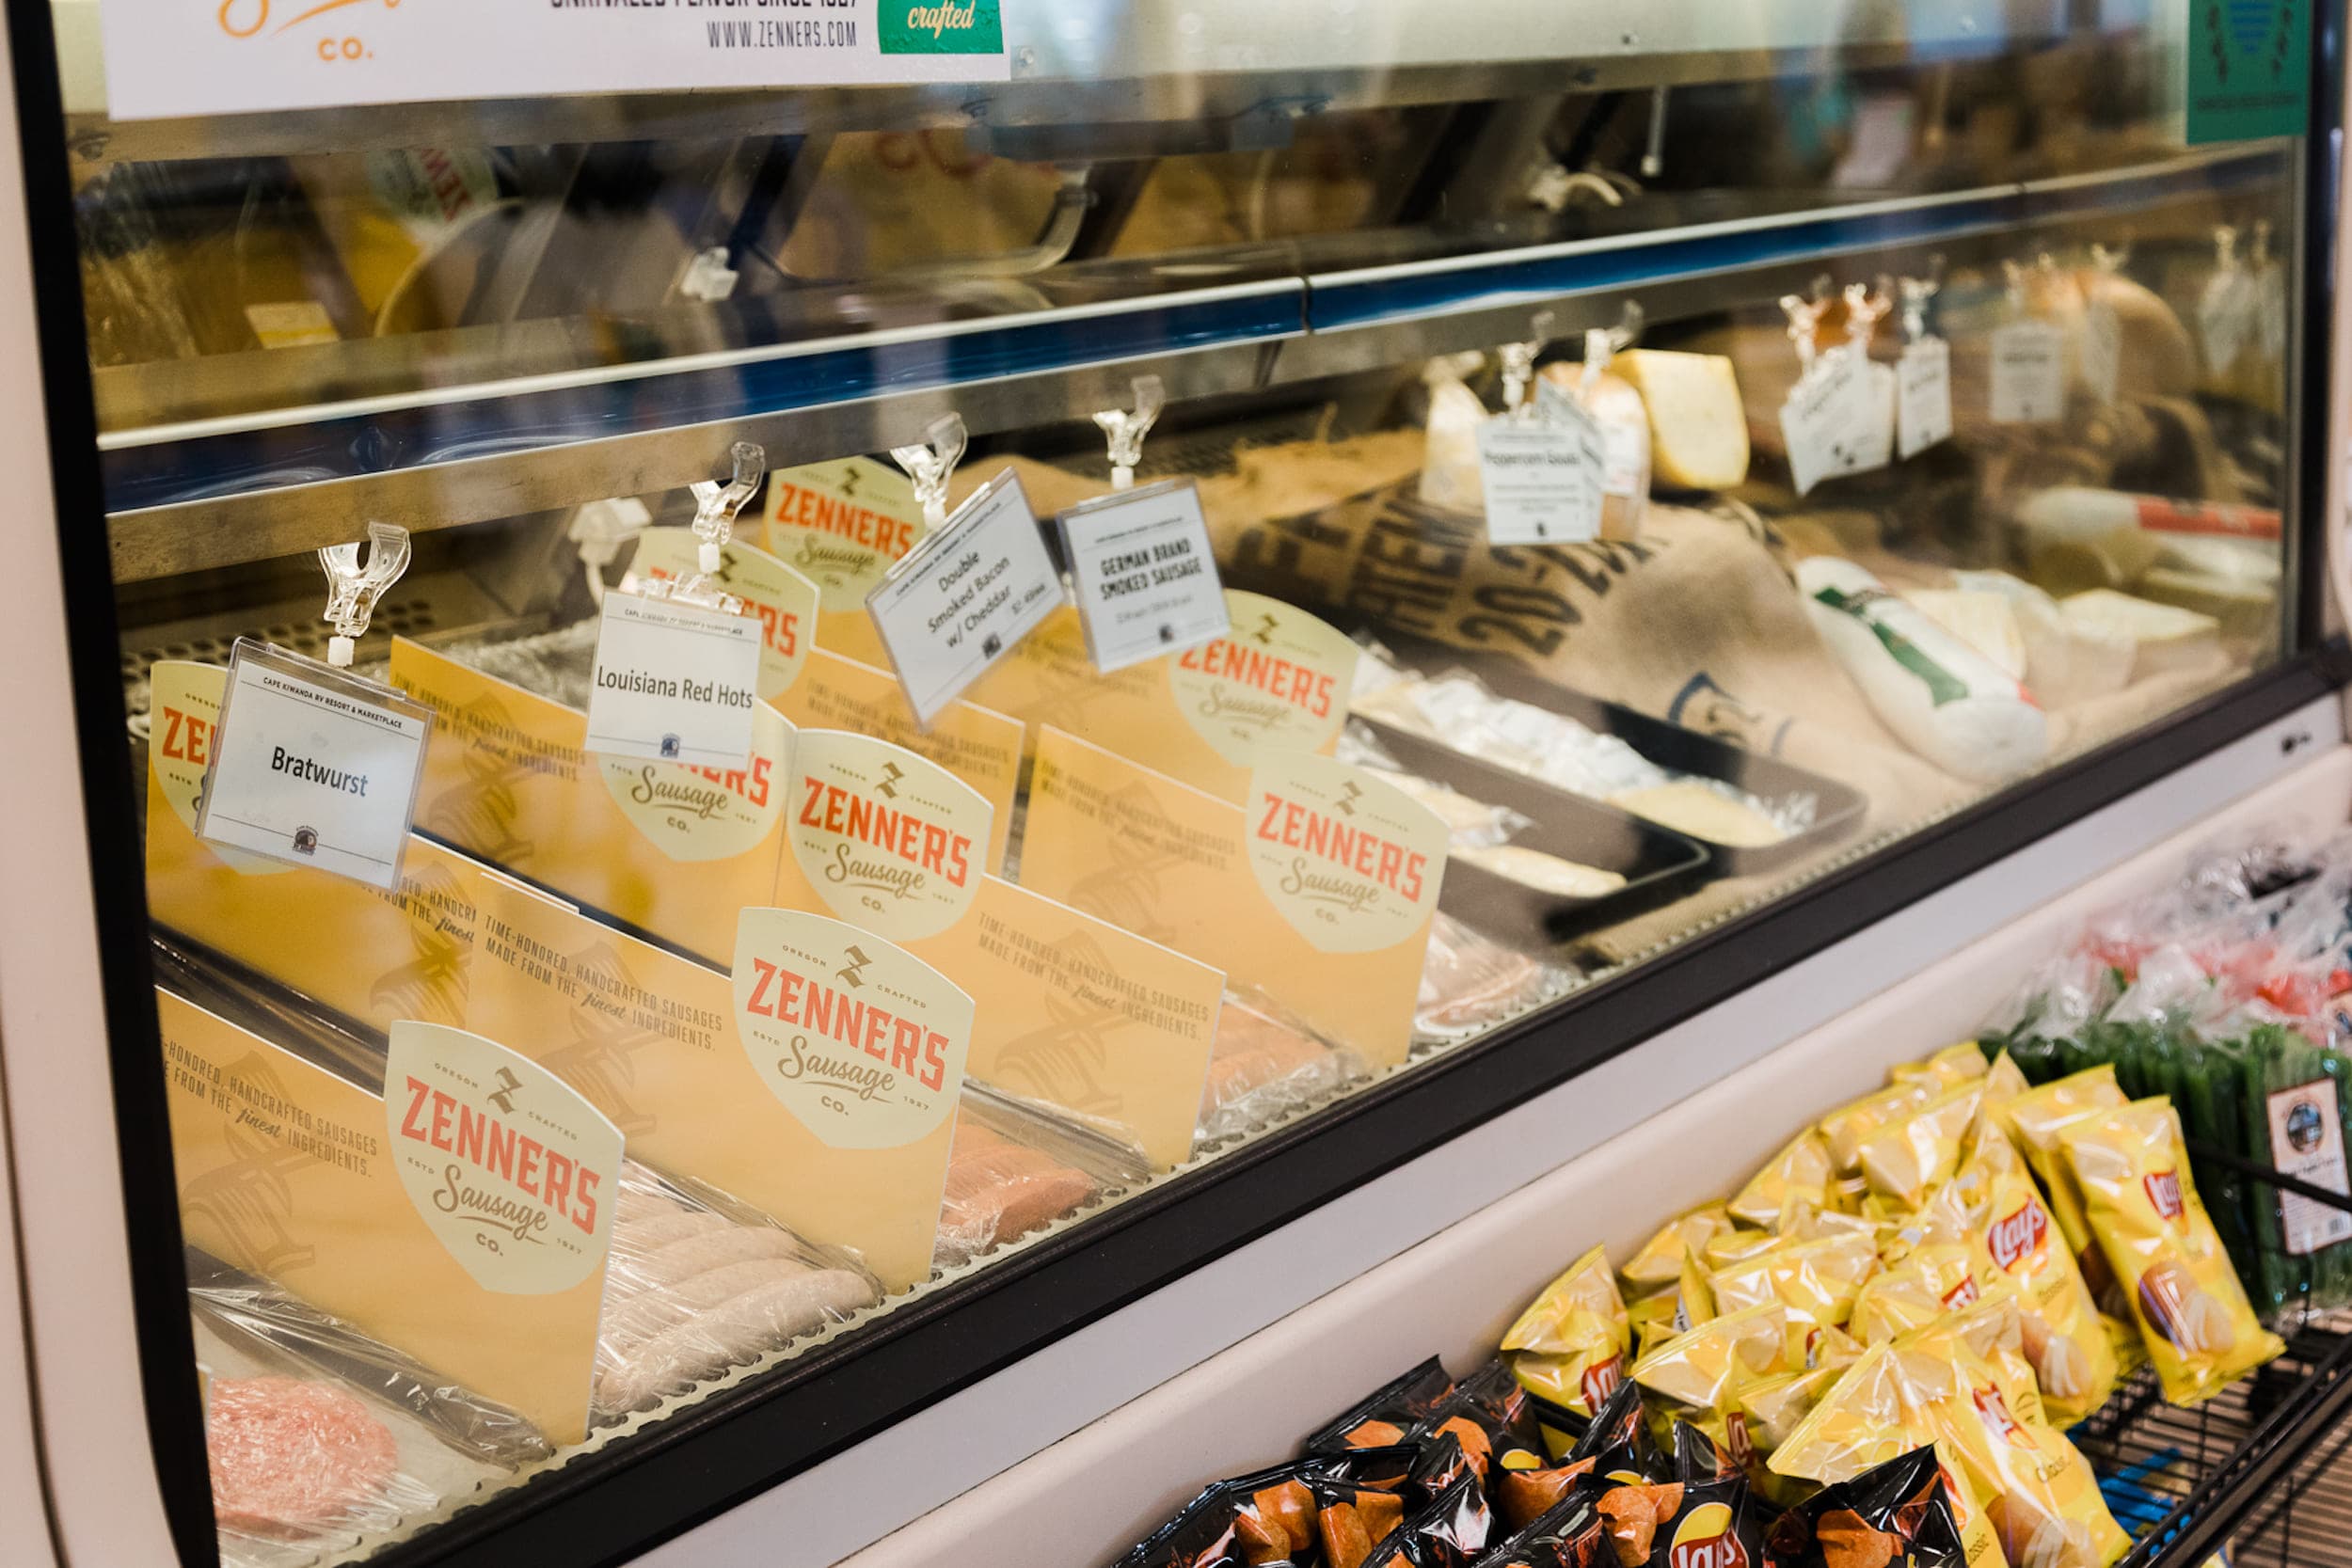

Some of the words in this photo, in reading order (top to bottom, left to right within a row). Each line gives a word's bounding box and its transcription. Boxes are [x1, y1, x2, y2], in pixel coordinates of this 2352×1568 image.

[706, 20, 857, 48] WWW.ZENNERS.COM
[938, 551, 980, 593] Double
[1099, 572, 1150, 601] SMOKED
[1152, 556, 1203, 586] SAUSAGE
[1100, 549, 1151, 577] GERMAN
[1152, 536, 1191, 562] BRAND
[928, 584, 976, 633] Smoked
[974, 556, 1011, 593] Bacon
[964, 585, 1011, 632] Cheddar
[263, 676, 281, 689] CAPE
[282, 679, 313, 700] KIWANDA
[325, 695, 351, 712] RESORT
[358, 706, 403, 729] MARKETPLACE
[596, 665, 678, 698] Louisiana
[682, 677, 713, 704] Red
[717, 683, 754, 709] Hots
[271, 745, 369, 799] Bratwurst
[631, 765, 728, 820] Sausage
[799, 775, 972, 889] ZENNER'S
[1256, 791, 1427, 904] ZENNER'S
[825, 843, 926, 900] Sausage
[1279, 856, 1380, 911] Sausage
[782, 943, 828, 968] OREGON
[877, 984, 928, 1010] CRAFTED
[977, 933, 1009, 962] MADE
[1012, 950, 1044, 980] FROM
[1048, 968, 1069, 990] THE
[1068, 958, 1147, 1003] HANDCRAFTED
[1151, 990, 1210, 1022] SAUSAGES
[485, 936, 517, 968] MADE
[520, 956, 553, 987] FROM
[556, 974, 578, 999] THE
[580, 990, 627, 1021] finest
[631, 1008, 717, 1053] INGREDIENTS.
[575, 961, 658, 1011] HANDCRAFTED
[661, 998, 723, 1033] SAUSAGES
[747, 957, 950, 1093] ZENNER'S
[777, 1035, 897, 1101] Sausage
[173, 1067, 206, 1101] FROM
[210, 1087, 231, 1115] THE
[234, 1105, 282, 1139] finest
[287, 1127, 373, 1179] INGREDIENTS.
[229, 1075, 312, 1131] HANDCRAFTED
[316, 1117, 378, 1157] SAUSAGES
[434, 1062, 479, 1089] OREGON
[528, 1110, 579, 1142] CRAFTED
[819, 1095, 850, 1117] CO.
[401, 1074, 601, 1235] ZENNER'S
[433, 1164, 548, 1242] Sausage
[475, 1232, 504, 1258] CO.
